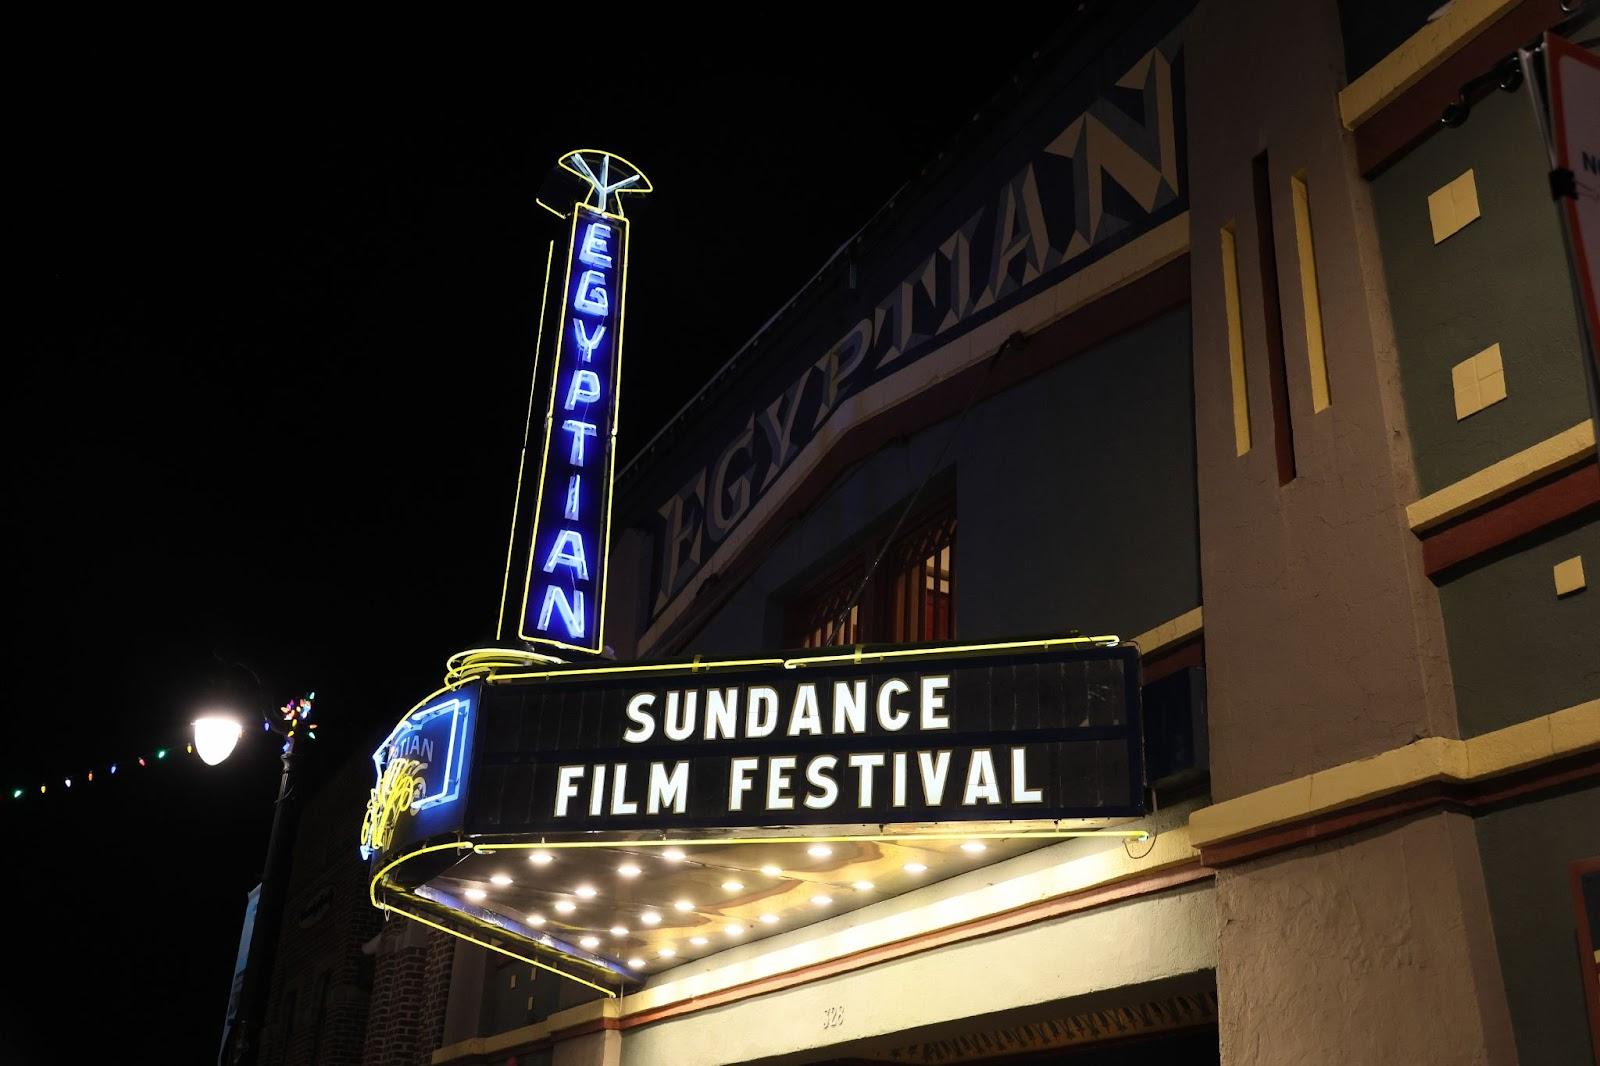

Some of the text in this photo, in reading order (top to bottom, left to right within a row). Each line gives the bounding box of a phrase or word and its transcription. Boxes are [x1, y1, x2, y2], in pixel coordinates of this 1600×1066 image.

[654, 46, 1184, 608] EGYPTIAN
[537, 222, 612, 638] EGYPTIAN
[622, 675, 951, 744] SUNDANCE
[553, 747, 1044, 817] FILM FESTIVAL
[823, 1004, 845, 1030] 328
